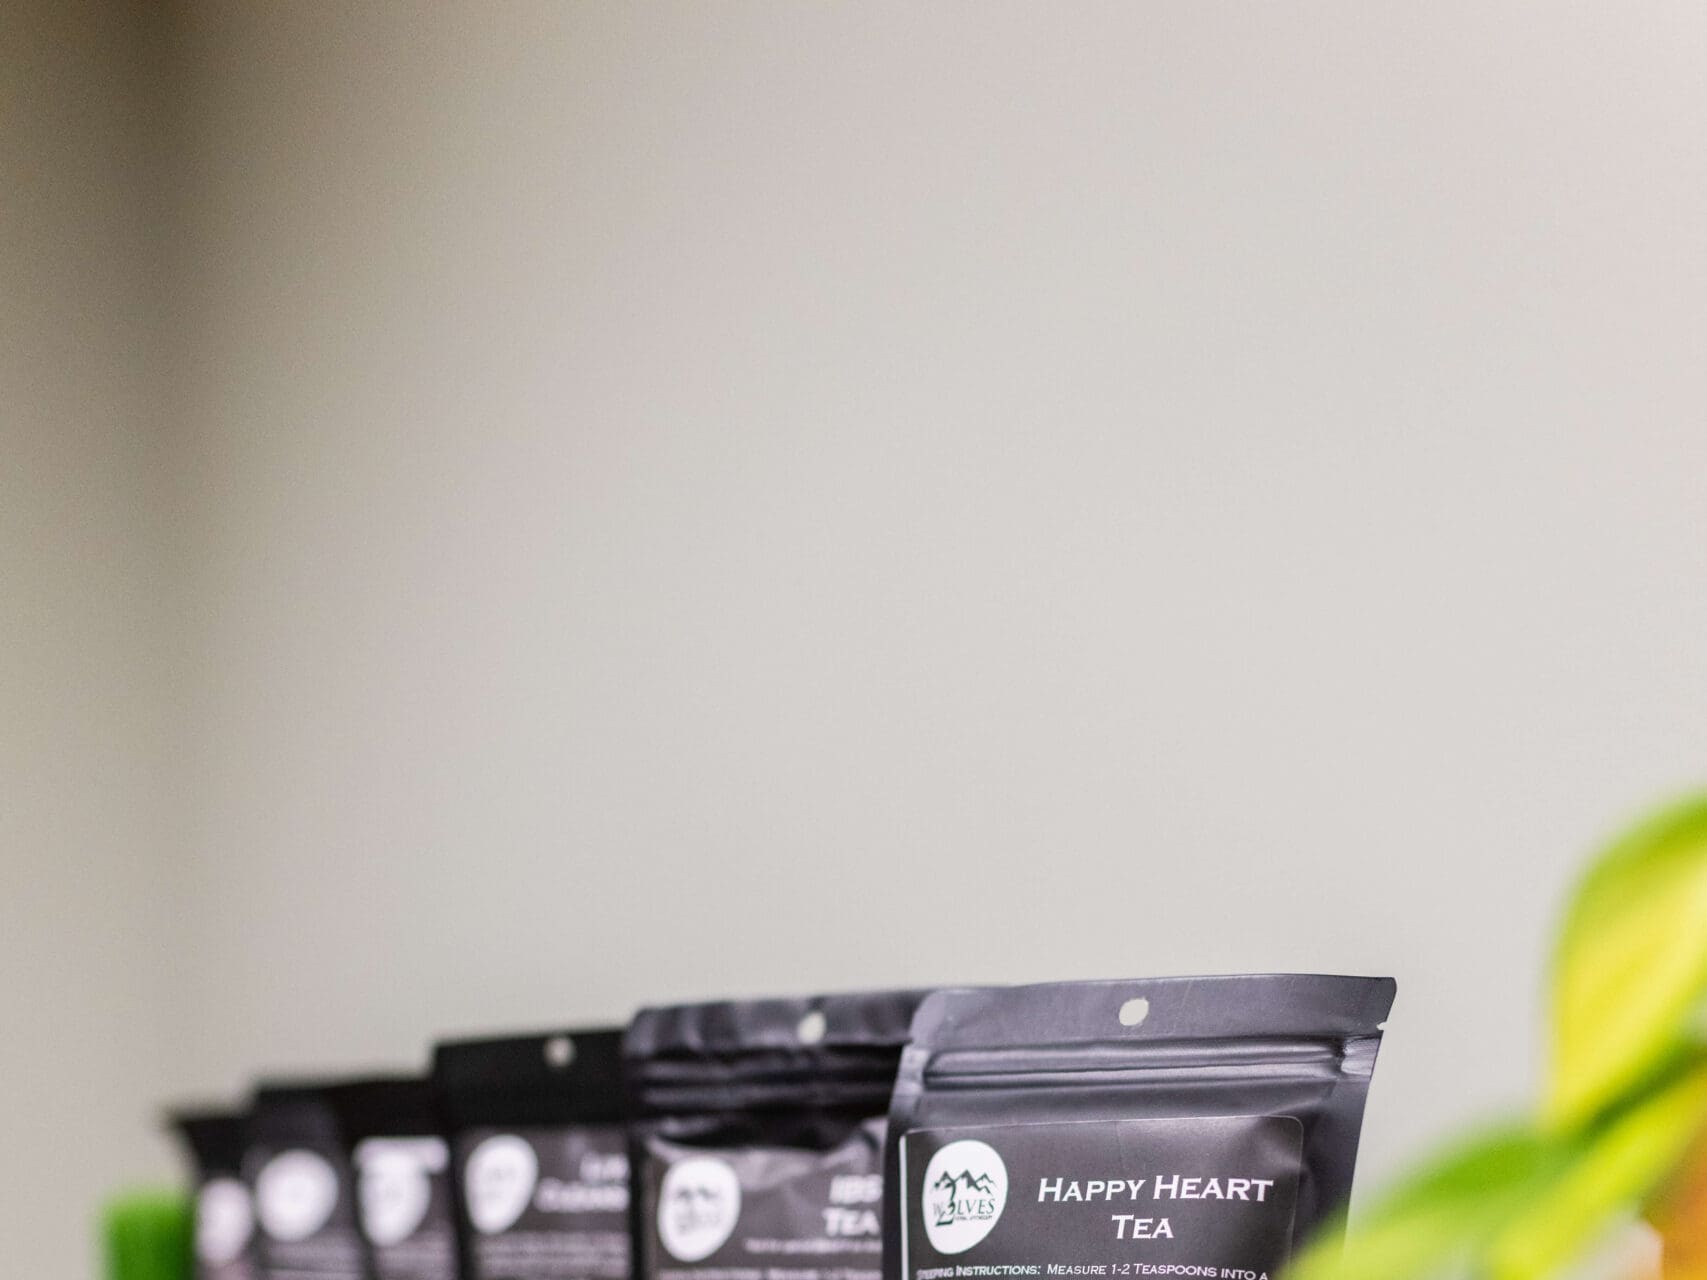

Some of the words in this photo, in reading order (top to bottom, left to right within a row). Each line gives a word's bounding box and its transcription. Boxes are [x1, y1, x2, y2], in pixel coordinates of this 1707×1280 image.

[1038, 1177, 1146, 1202] HAPPY
[1152, 1175, 1274, 1202] HEART
[822, 1207, 880, 1236] TEA
[1111, 1214, 1174, 1240] TEA
[956, 1265, 1041, 1277] INSTRUCTIONS:
[1047, 1263, 1107, 1275] MEASURE
[1111, 1263, 1130, 1275] 1-2
[1133, 1263, 1217, 1277] TEASPOONS
[1220, 1268, 1256, 1280] INTO
